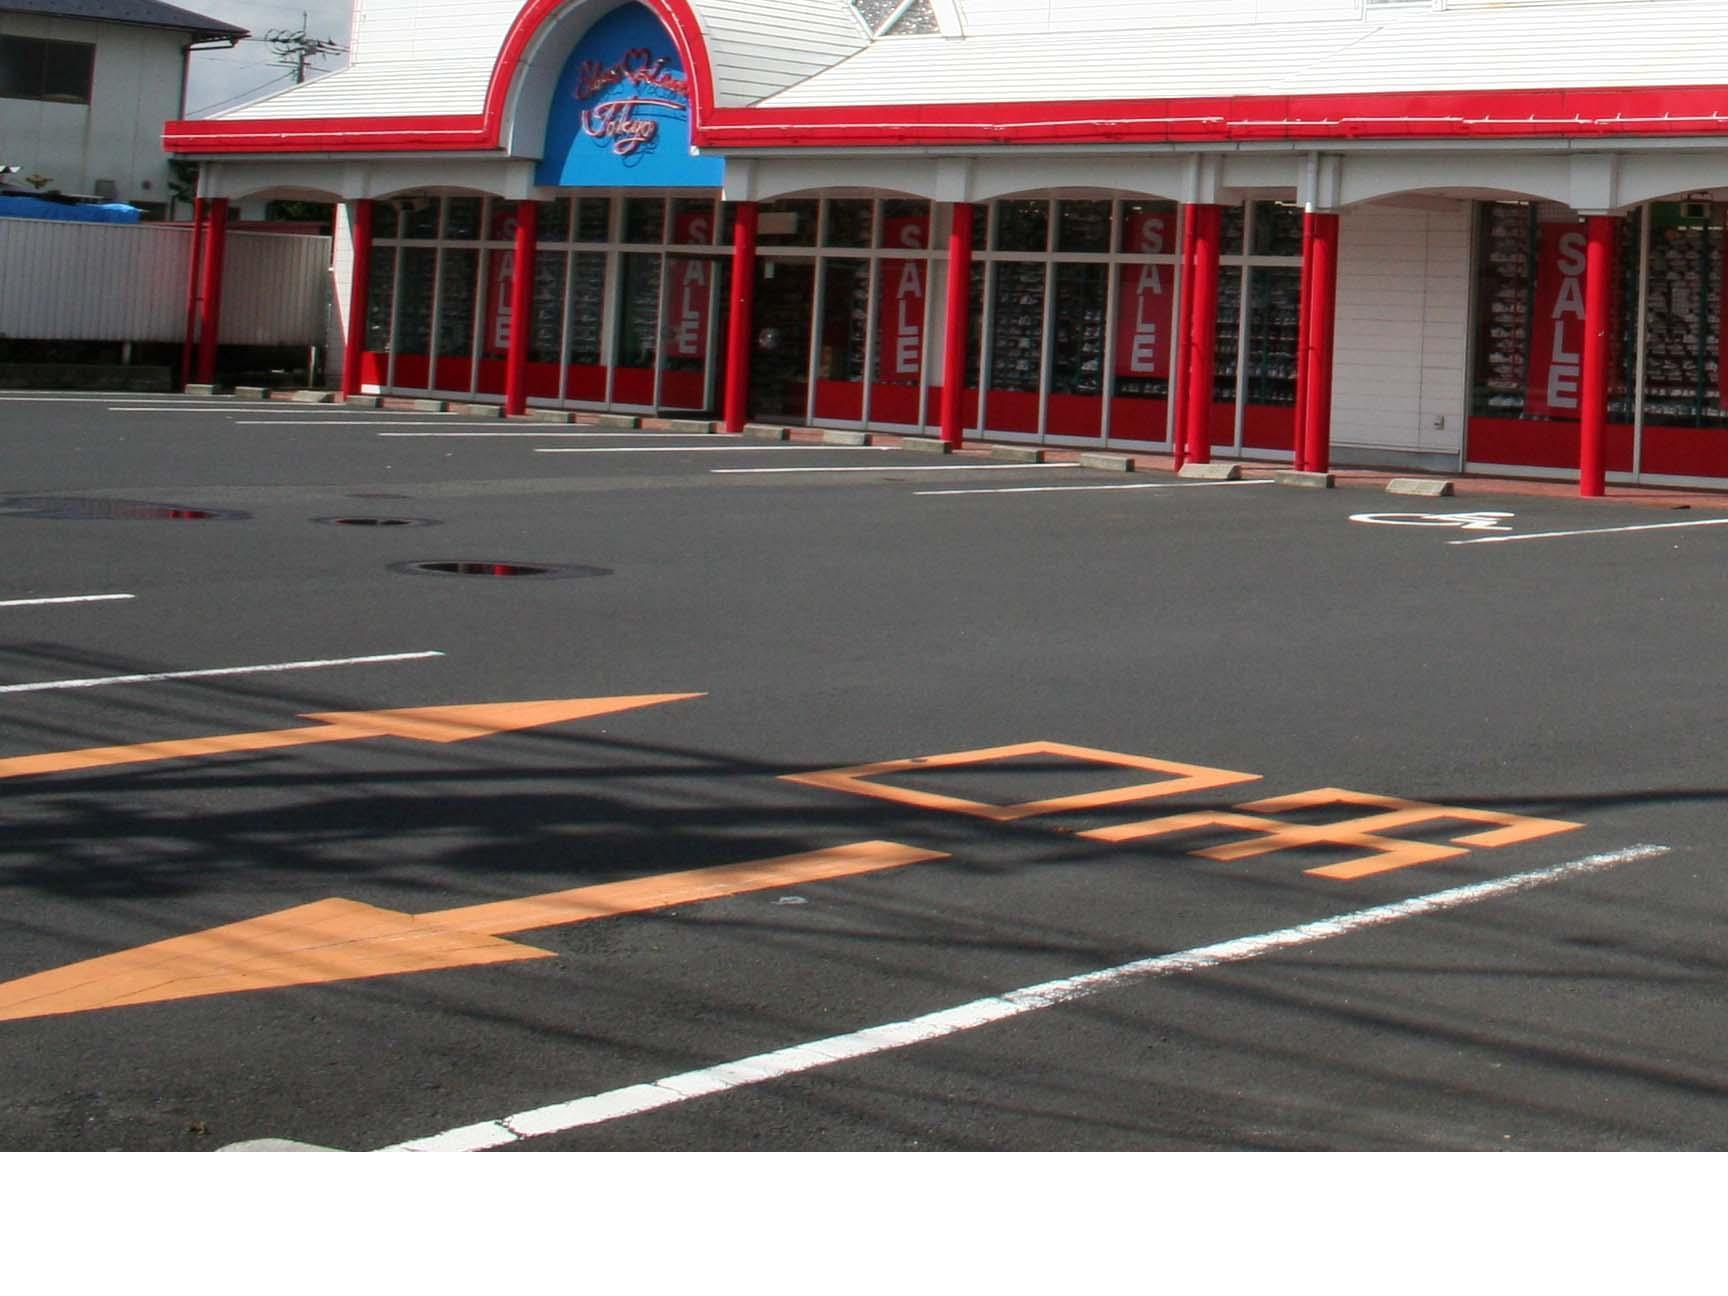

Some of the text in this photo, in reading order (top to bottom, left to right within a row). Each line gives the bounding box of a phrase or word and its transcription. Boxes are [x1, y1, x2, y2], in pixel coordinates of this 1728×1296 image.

[679, 218, 708, 354] SALE
[896, 222, 923, 374] SALE
[1130, 218, 1166, 373] SALE
[1546, 232, 1586, 409] SALE
